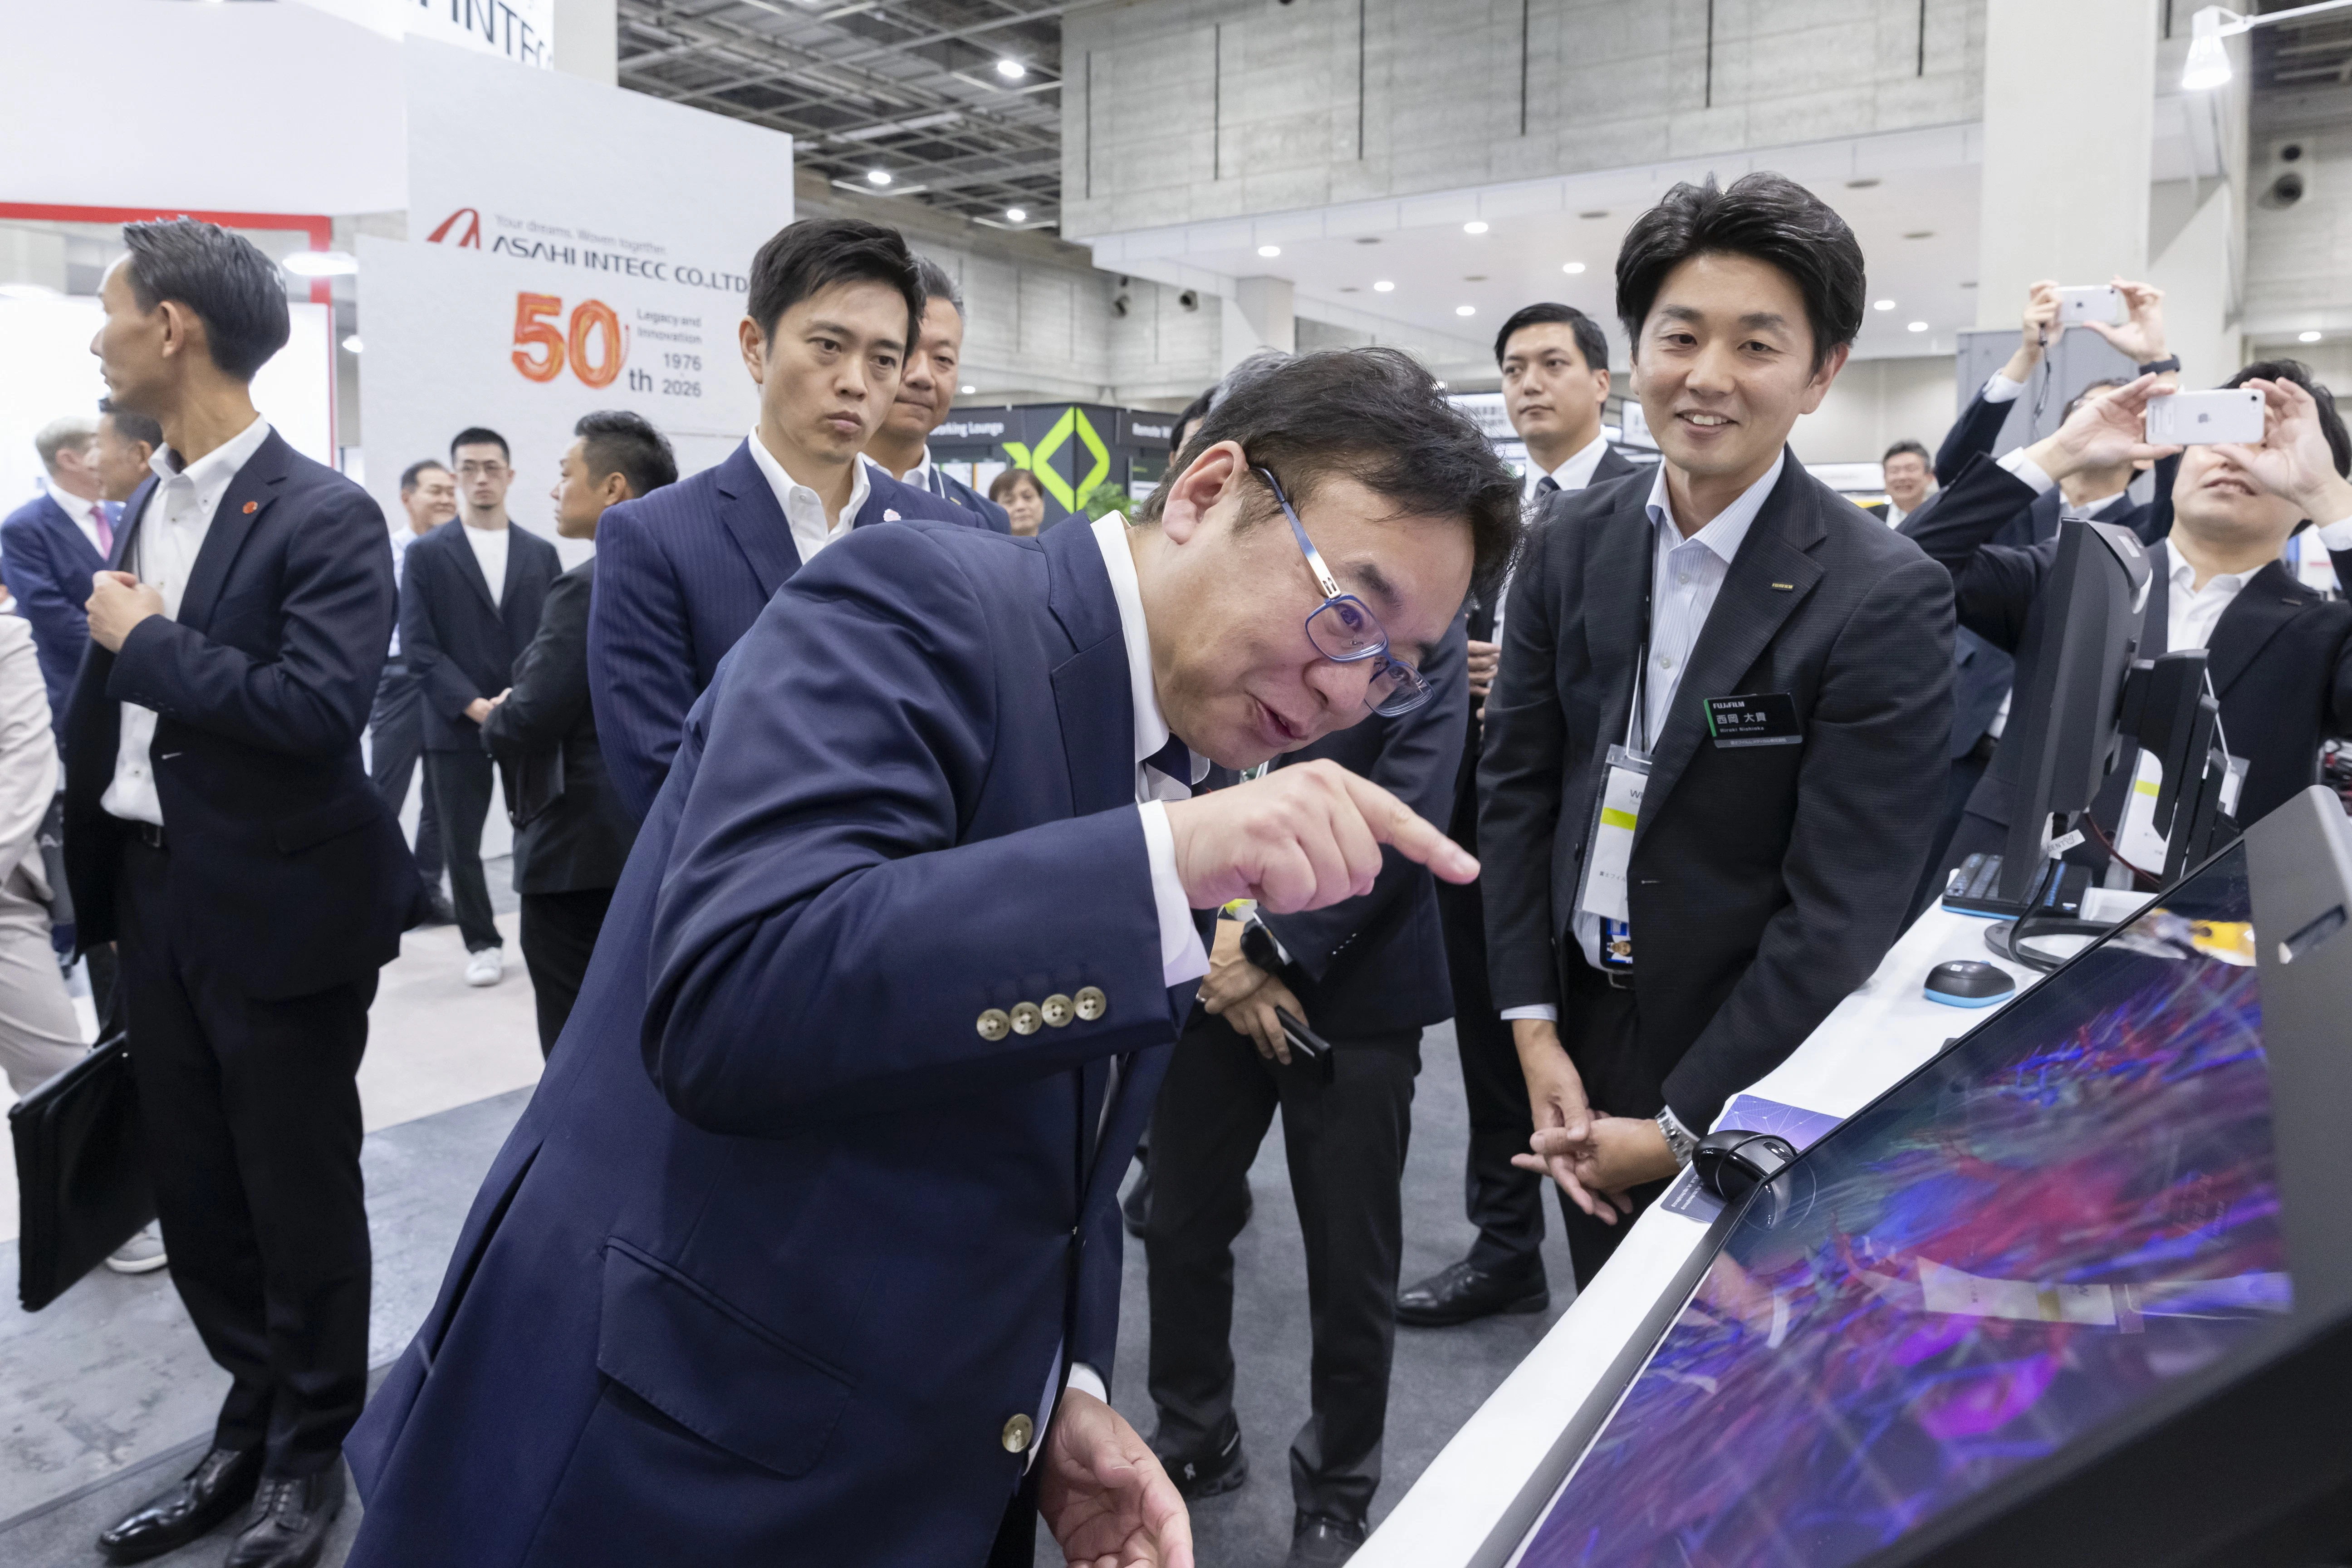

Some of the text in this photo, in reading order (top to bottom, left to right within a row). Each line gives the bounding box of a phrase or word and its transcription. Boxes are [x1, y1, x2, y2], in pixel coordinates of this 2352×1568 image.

[493, 235, 574, 265] ASAHI
[585, 250, 667, 281] INTECC
[664, 353, 701, 371] 1976
[662, 379, 701, 397] 2026
